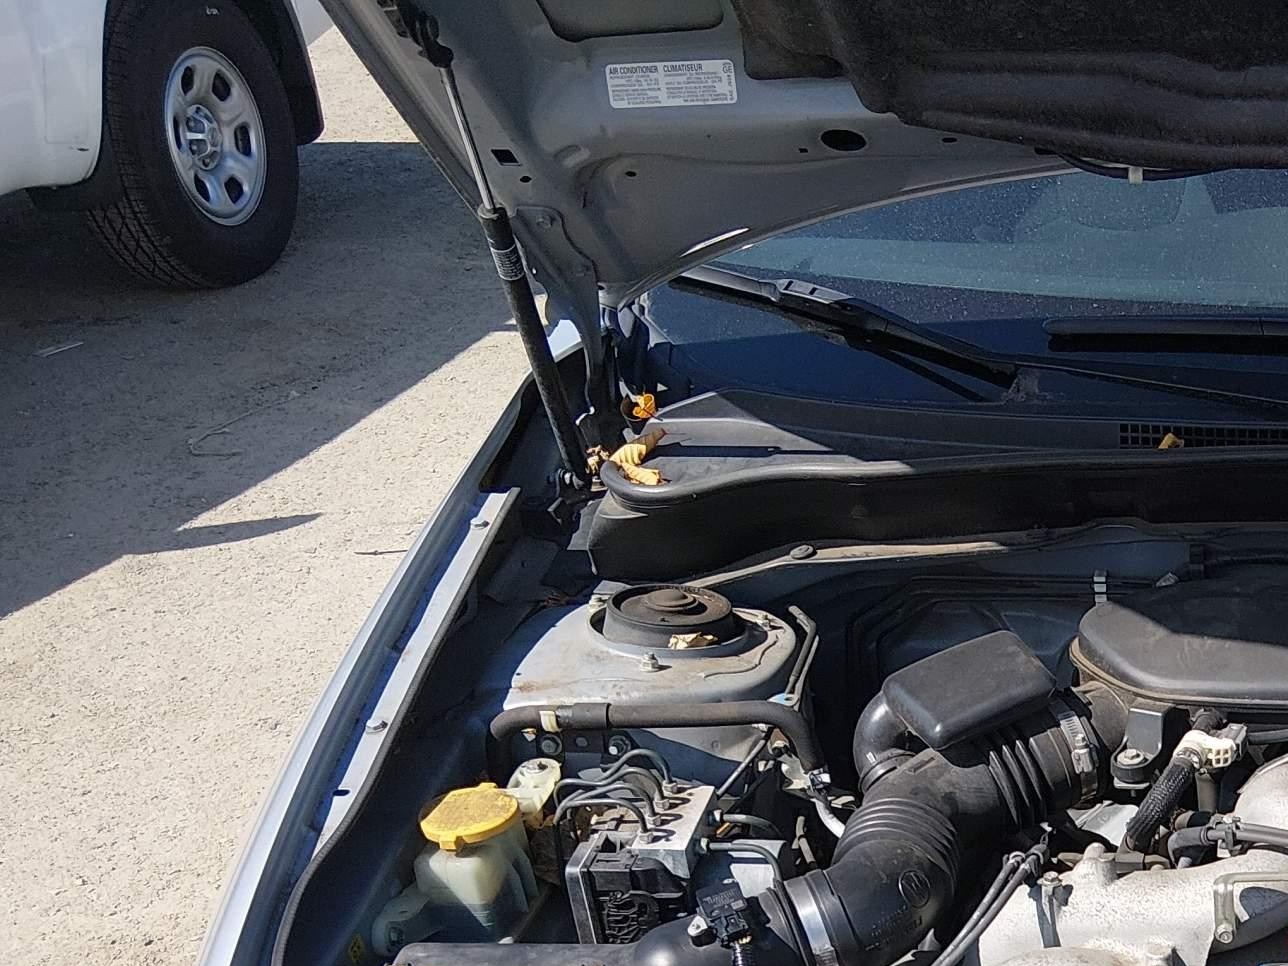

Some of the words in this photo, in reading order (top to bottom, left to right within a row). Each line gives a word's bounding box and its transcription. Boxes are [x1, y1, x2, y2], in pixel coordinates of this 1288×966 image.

[609, 66, 619, 75] AIR
[620, 65, 658, 75] CONDITIONER
[663, 63, 703, 73] CLIMATISEUR
